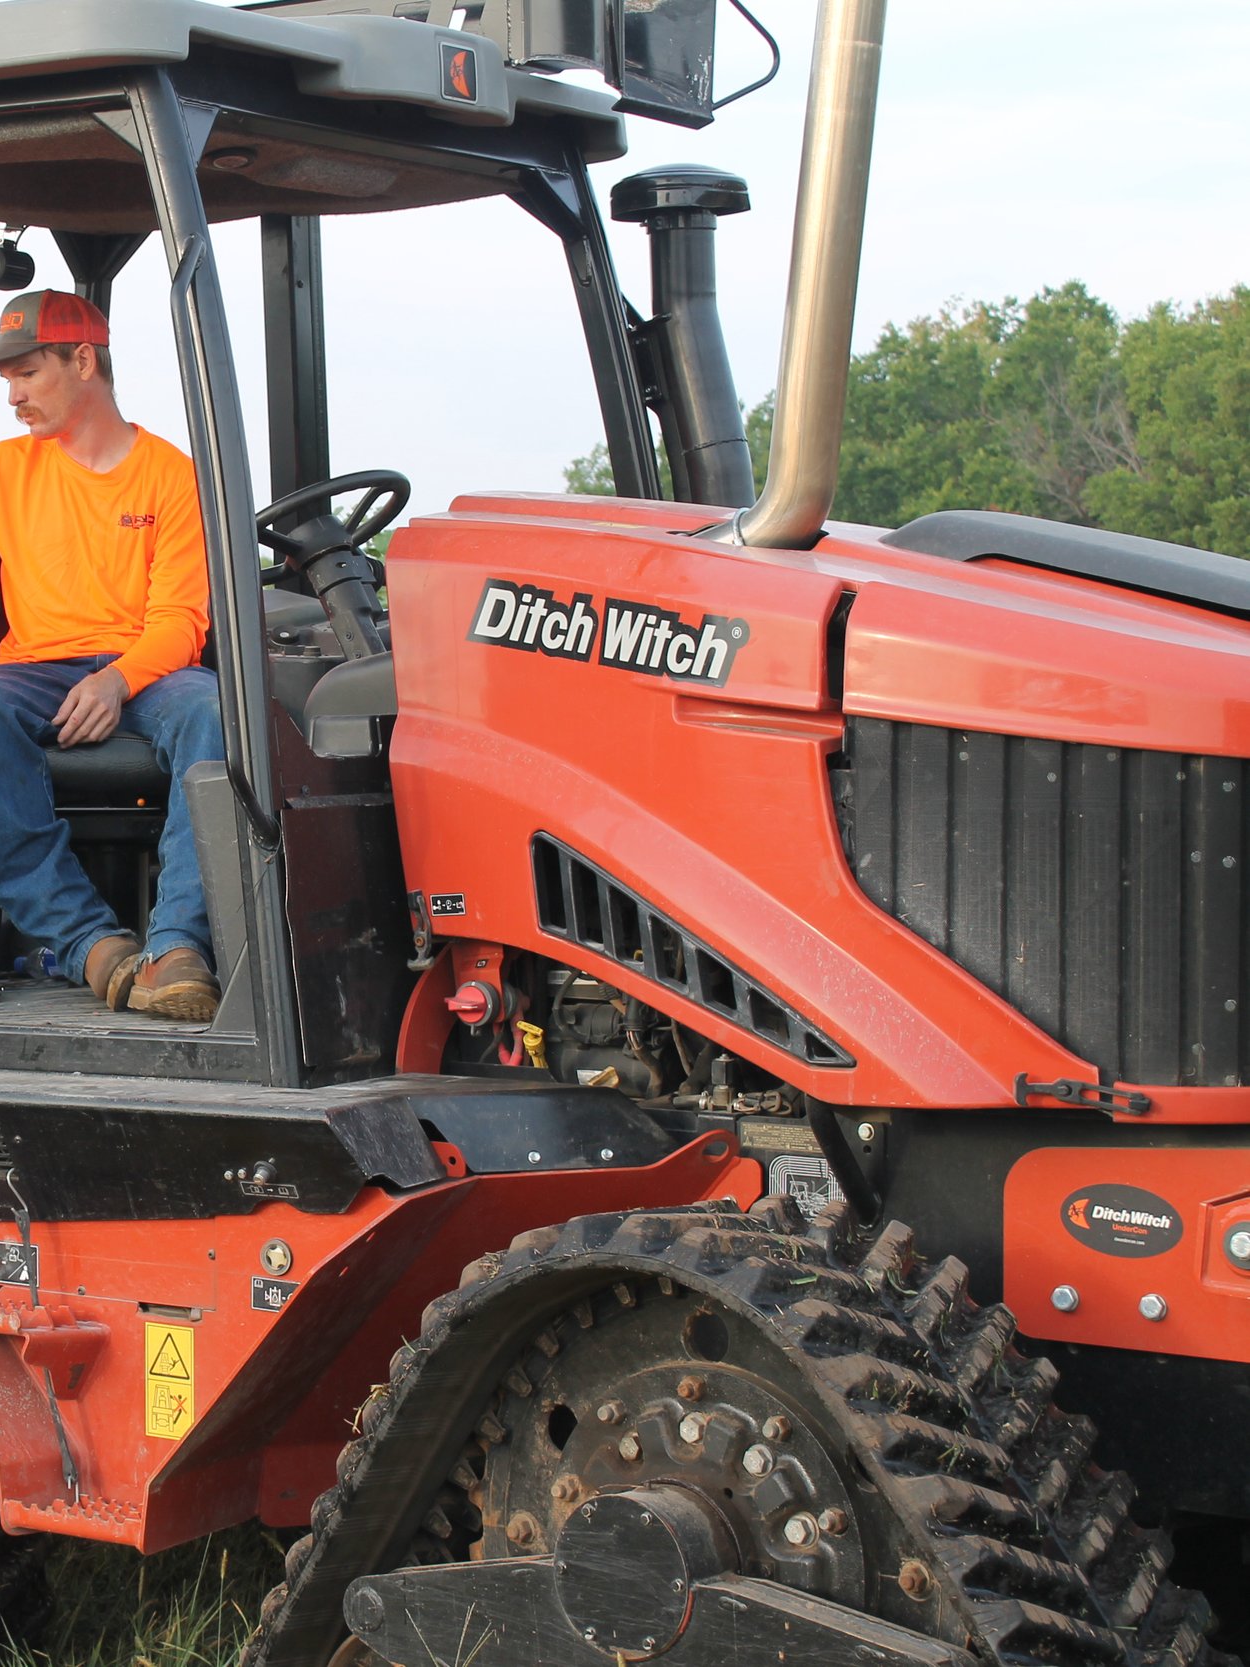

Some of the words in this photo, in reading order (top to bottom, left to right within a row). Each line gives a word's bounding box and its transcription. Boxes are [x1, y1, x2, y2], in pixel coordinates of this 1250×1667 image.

[474, 588, 594, 654] Ditch
[603, 607, 728, 680] Witch
[1112, 1223, 1148, 1235] UnderCon
